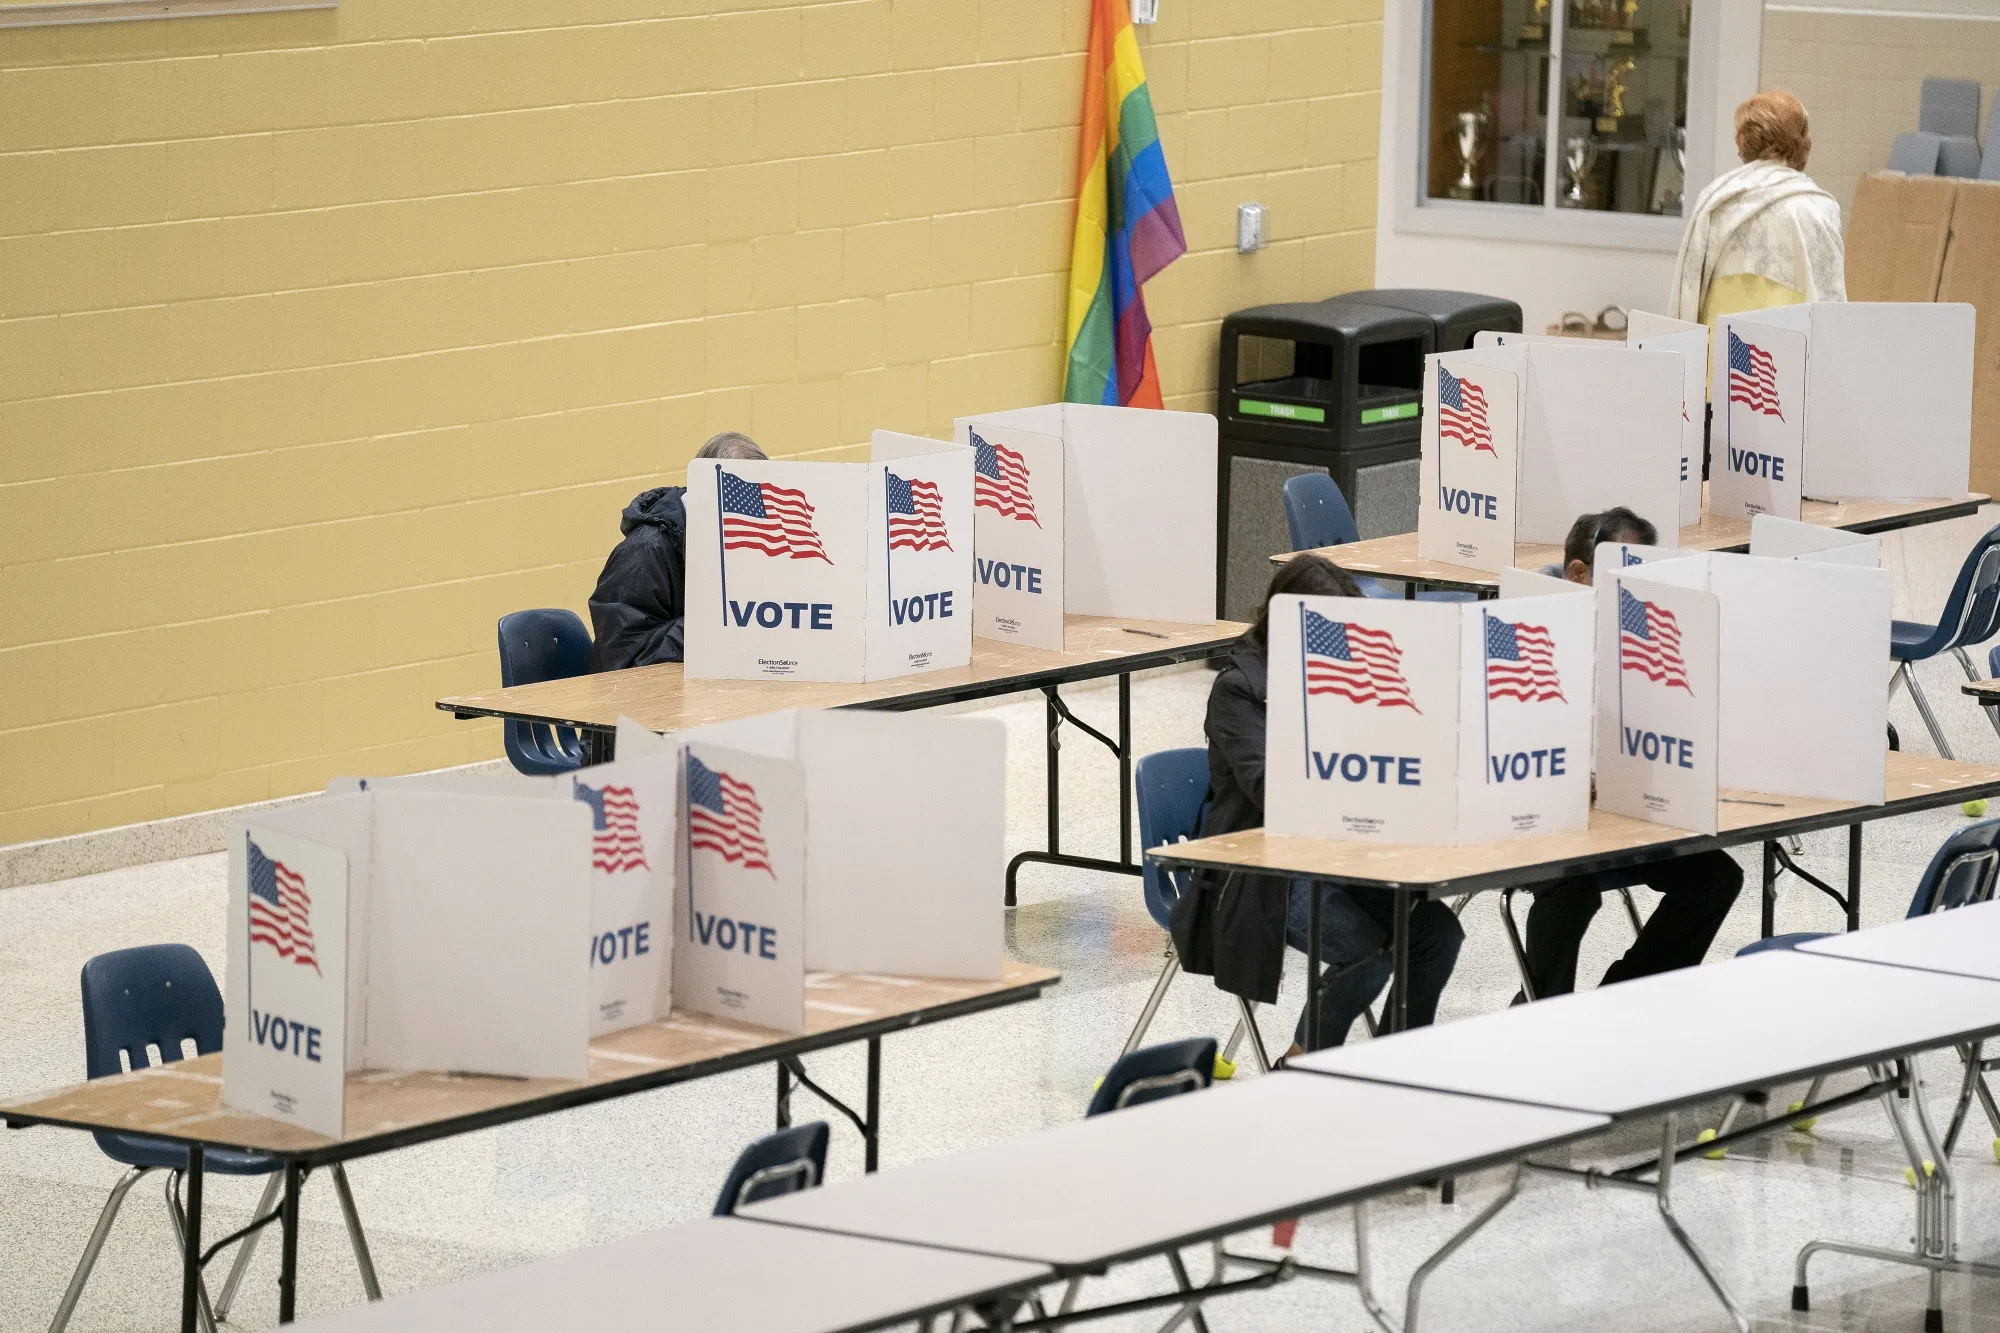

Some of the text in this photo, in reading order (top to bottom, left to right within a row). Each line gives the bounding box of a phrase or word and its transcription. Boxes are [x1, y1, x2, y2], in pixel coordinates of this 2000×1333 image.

[1731, 447, 1784, 481] VOTE
[1442, 486, 1497, 520] VOTE
[977, 558, 1041, 594] VOTE
[728, 600, 833, 630] VOTE
[892, 590, 953, 625] VOTE
[1491, 747, 1566, 783] VOTE
[1625, 726, 1694, 769] VOTE
[1312, 751, 1421, 786] VOTE
[695, 911, 777, 960] VOTE
[253, 1010, 322, 1062] VOTE
